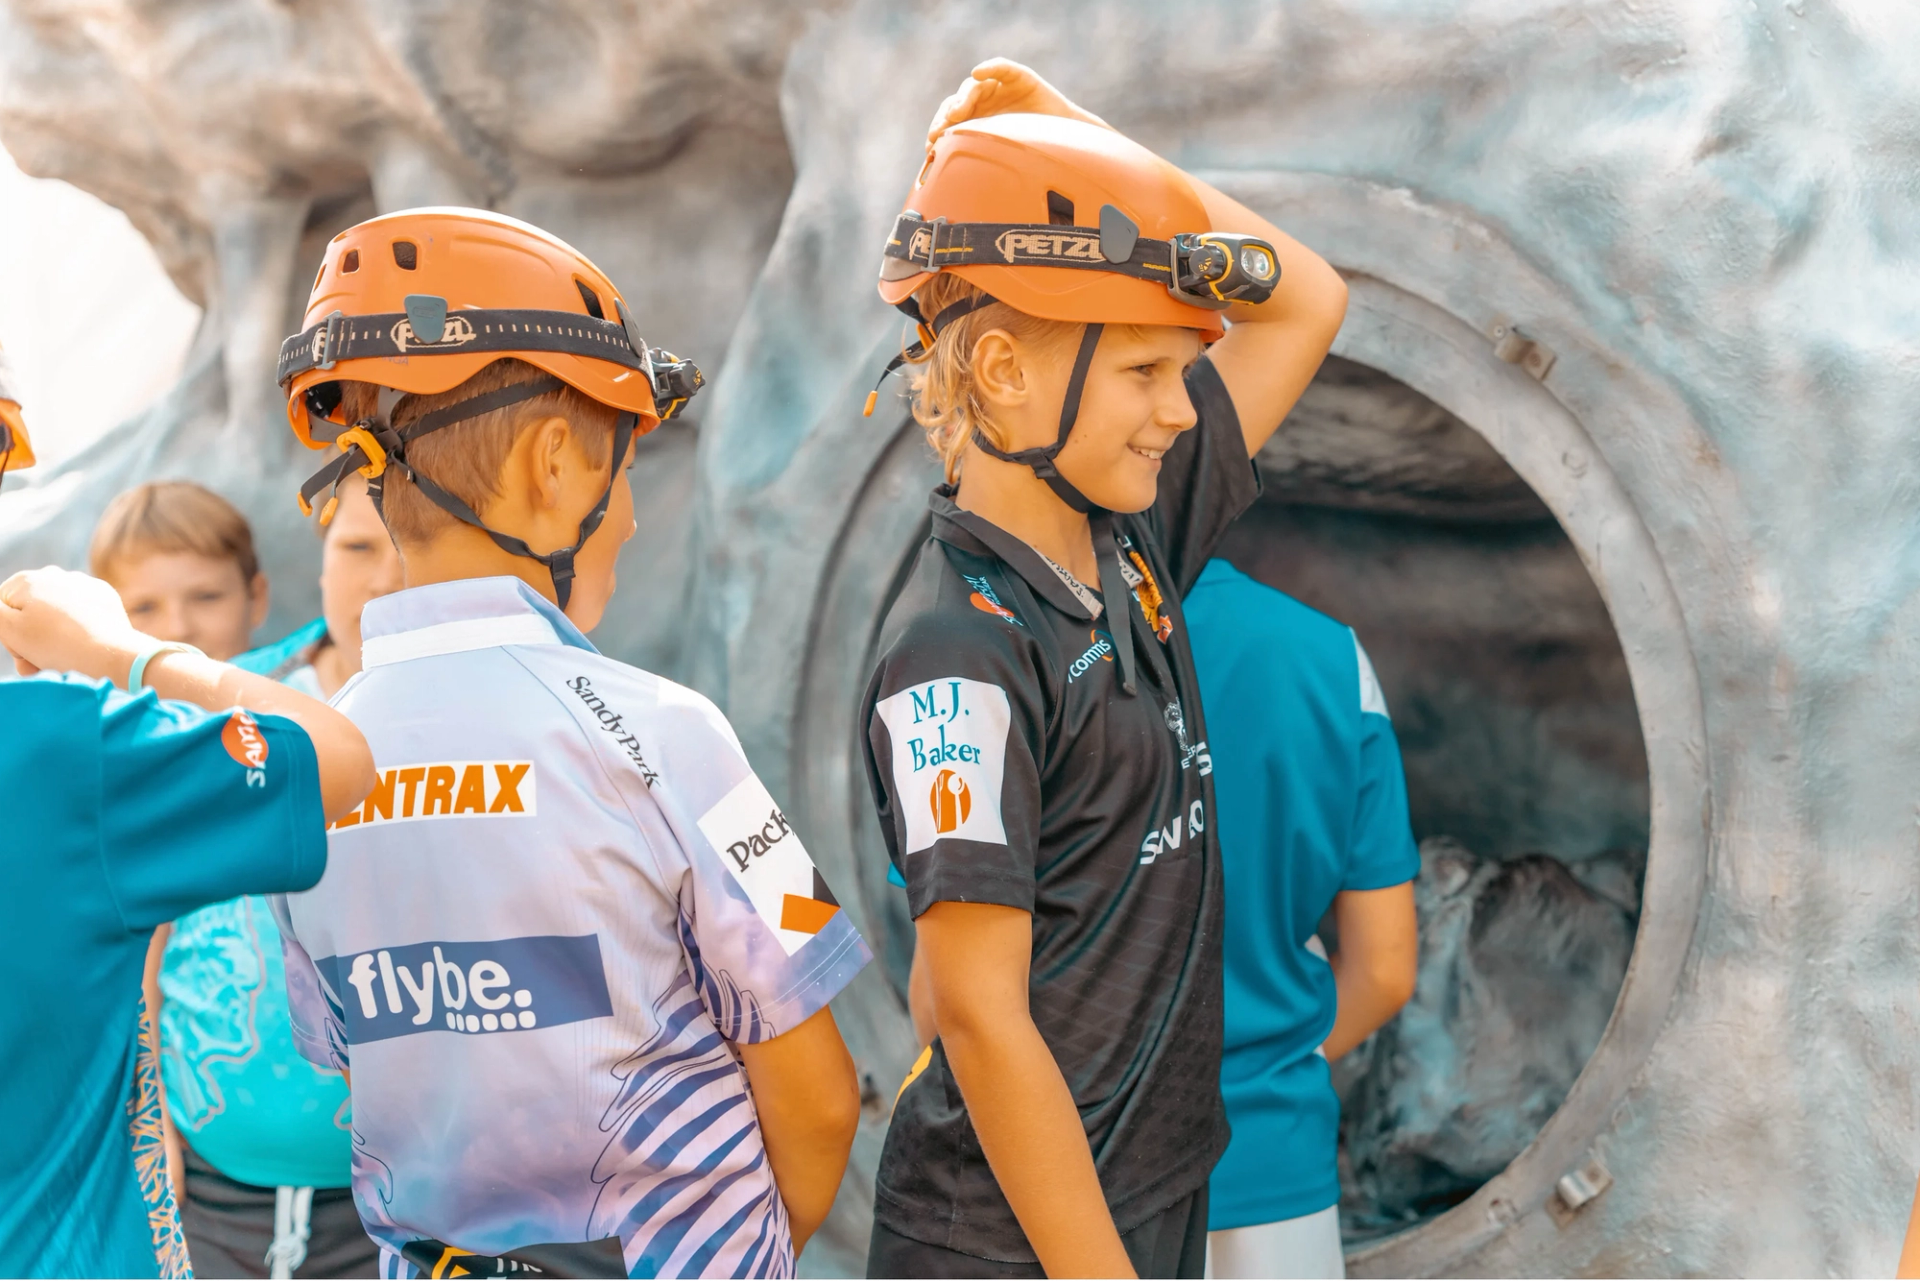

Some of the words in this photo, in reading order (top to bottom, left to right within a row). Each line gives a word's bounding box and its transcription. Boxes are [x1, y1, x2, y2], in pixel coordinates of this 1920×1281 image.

[1067, 638, 1112, 684] comms
[908, 681, 971, 725] M.J.
[565, 675, 626, 741] Sandy
[615, 733, 662, 791] Park
[906, 723, 981, 773] Baker
[325, 763, 531, 832] NTRAX
